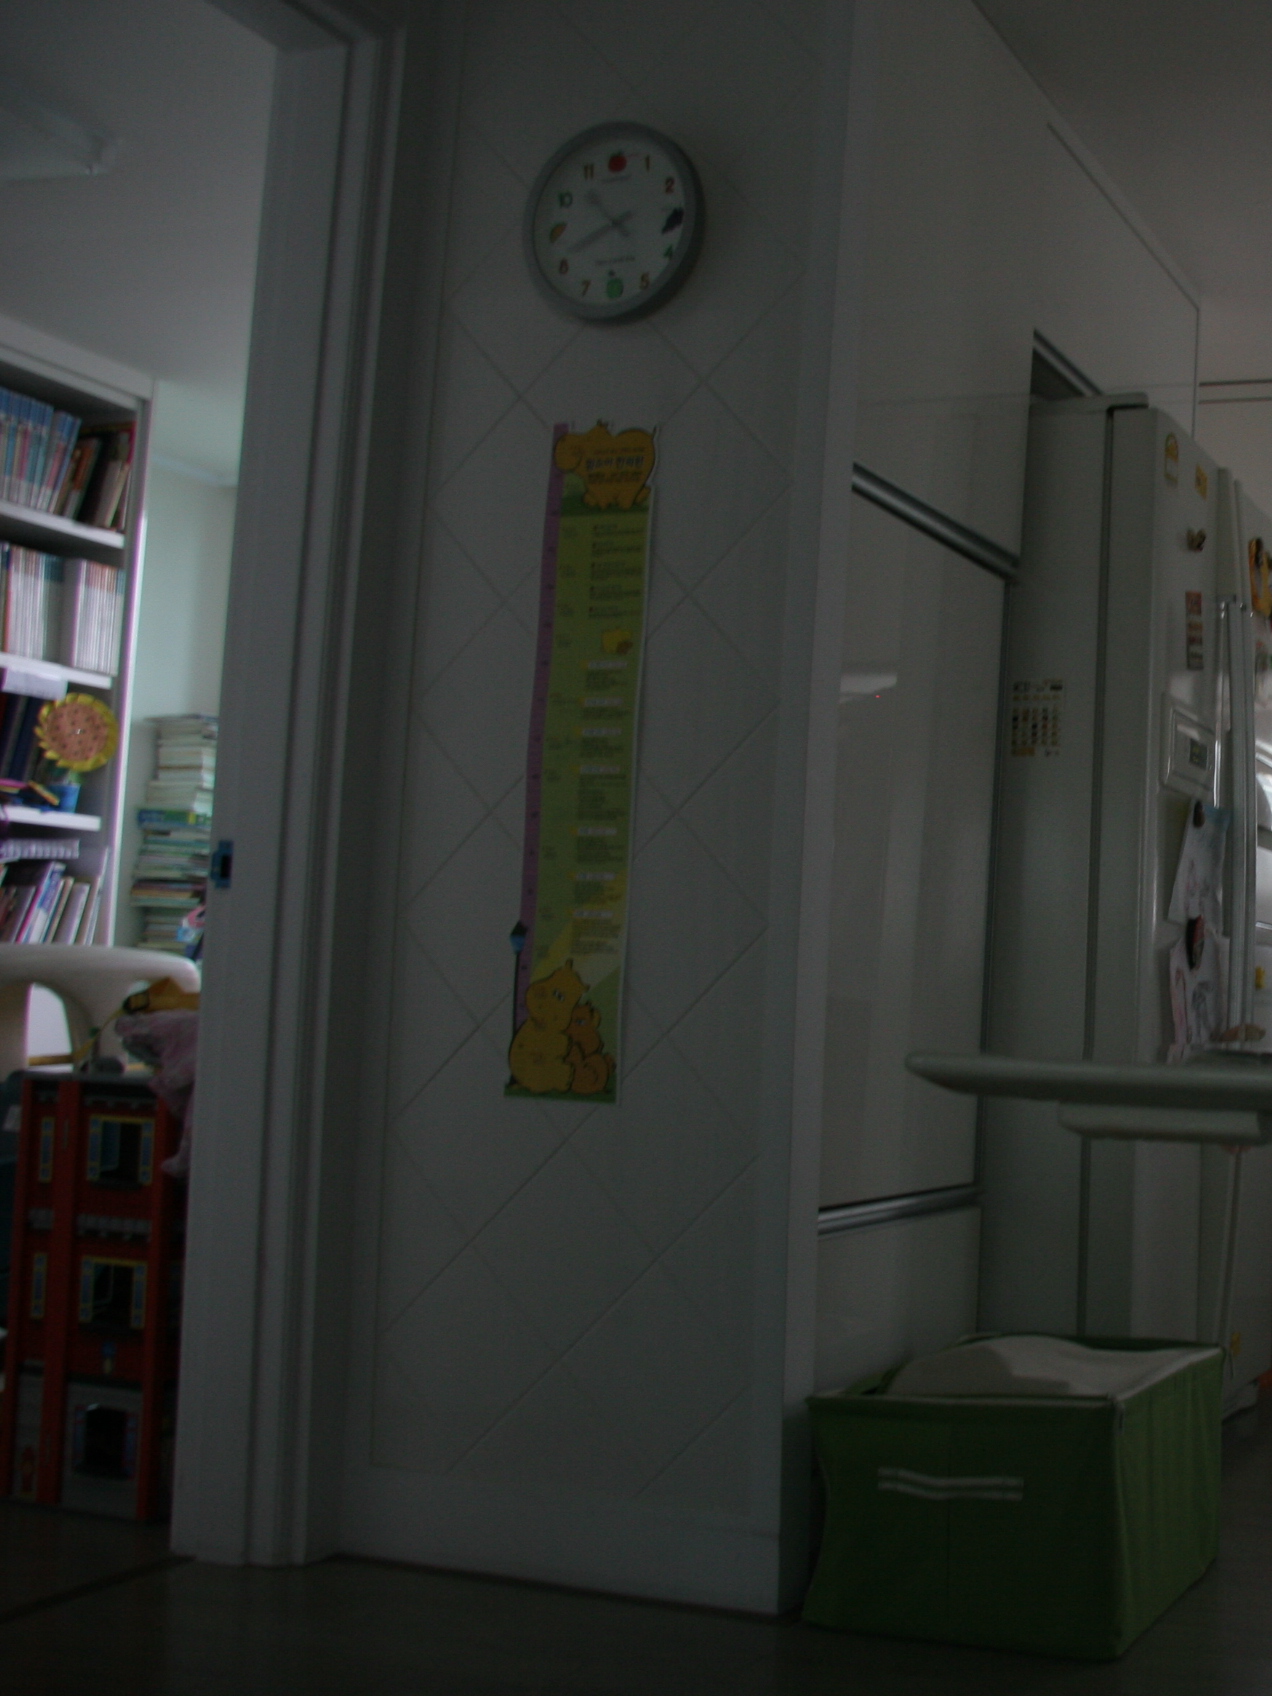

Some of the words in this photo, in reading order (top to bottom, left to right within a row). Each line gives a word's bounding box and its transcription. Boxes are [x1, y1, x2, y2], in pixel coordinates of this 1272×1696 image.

[583, 164, 595, 180] 11
[665, 176, 675, 194] 2
[558, 191, 573, 207] 10
[581, 280, 591, 296] 7
[640, 272, 650, 290] 5
